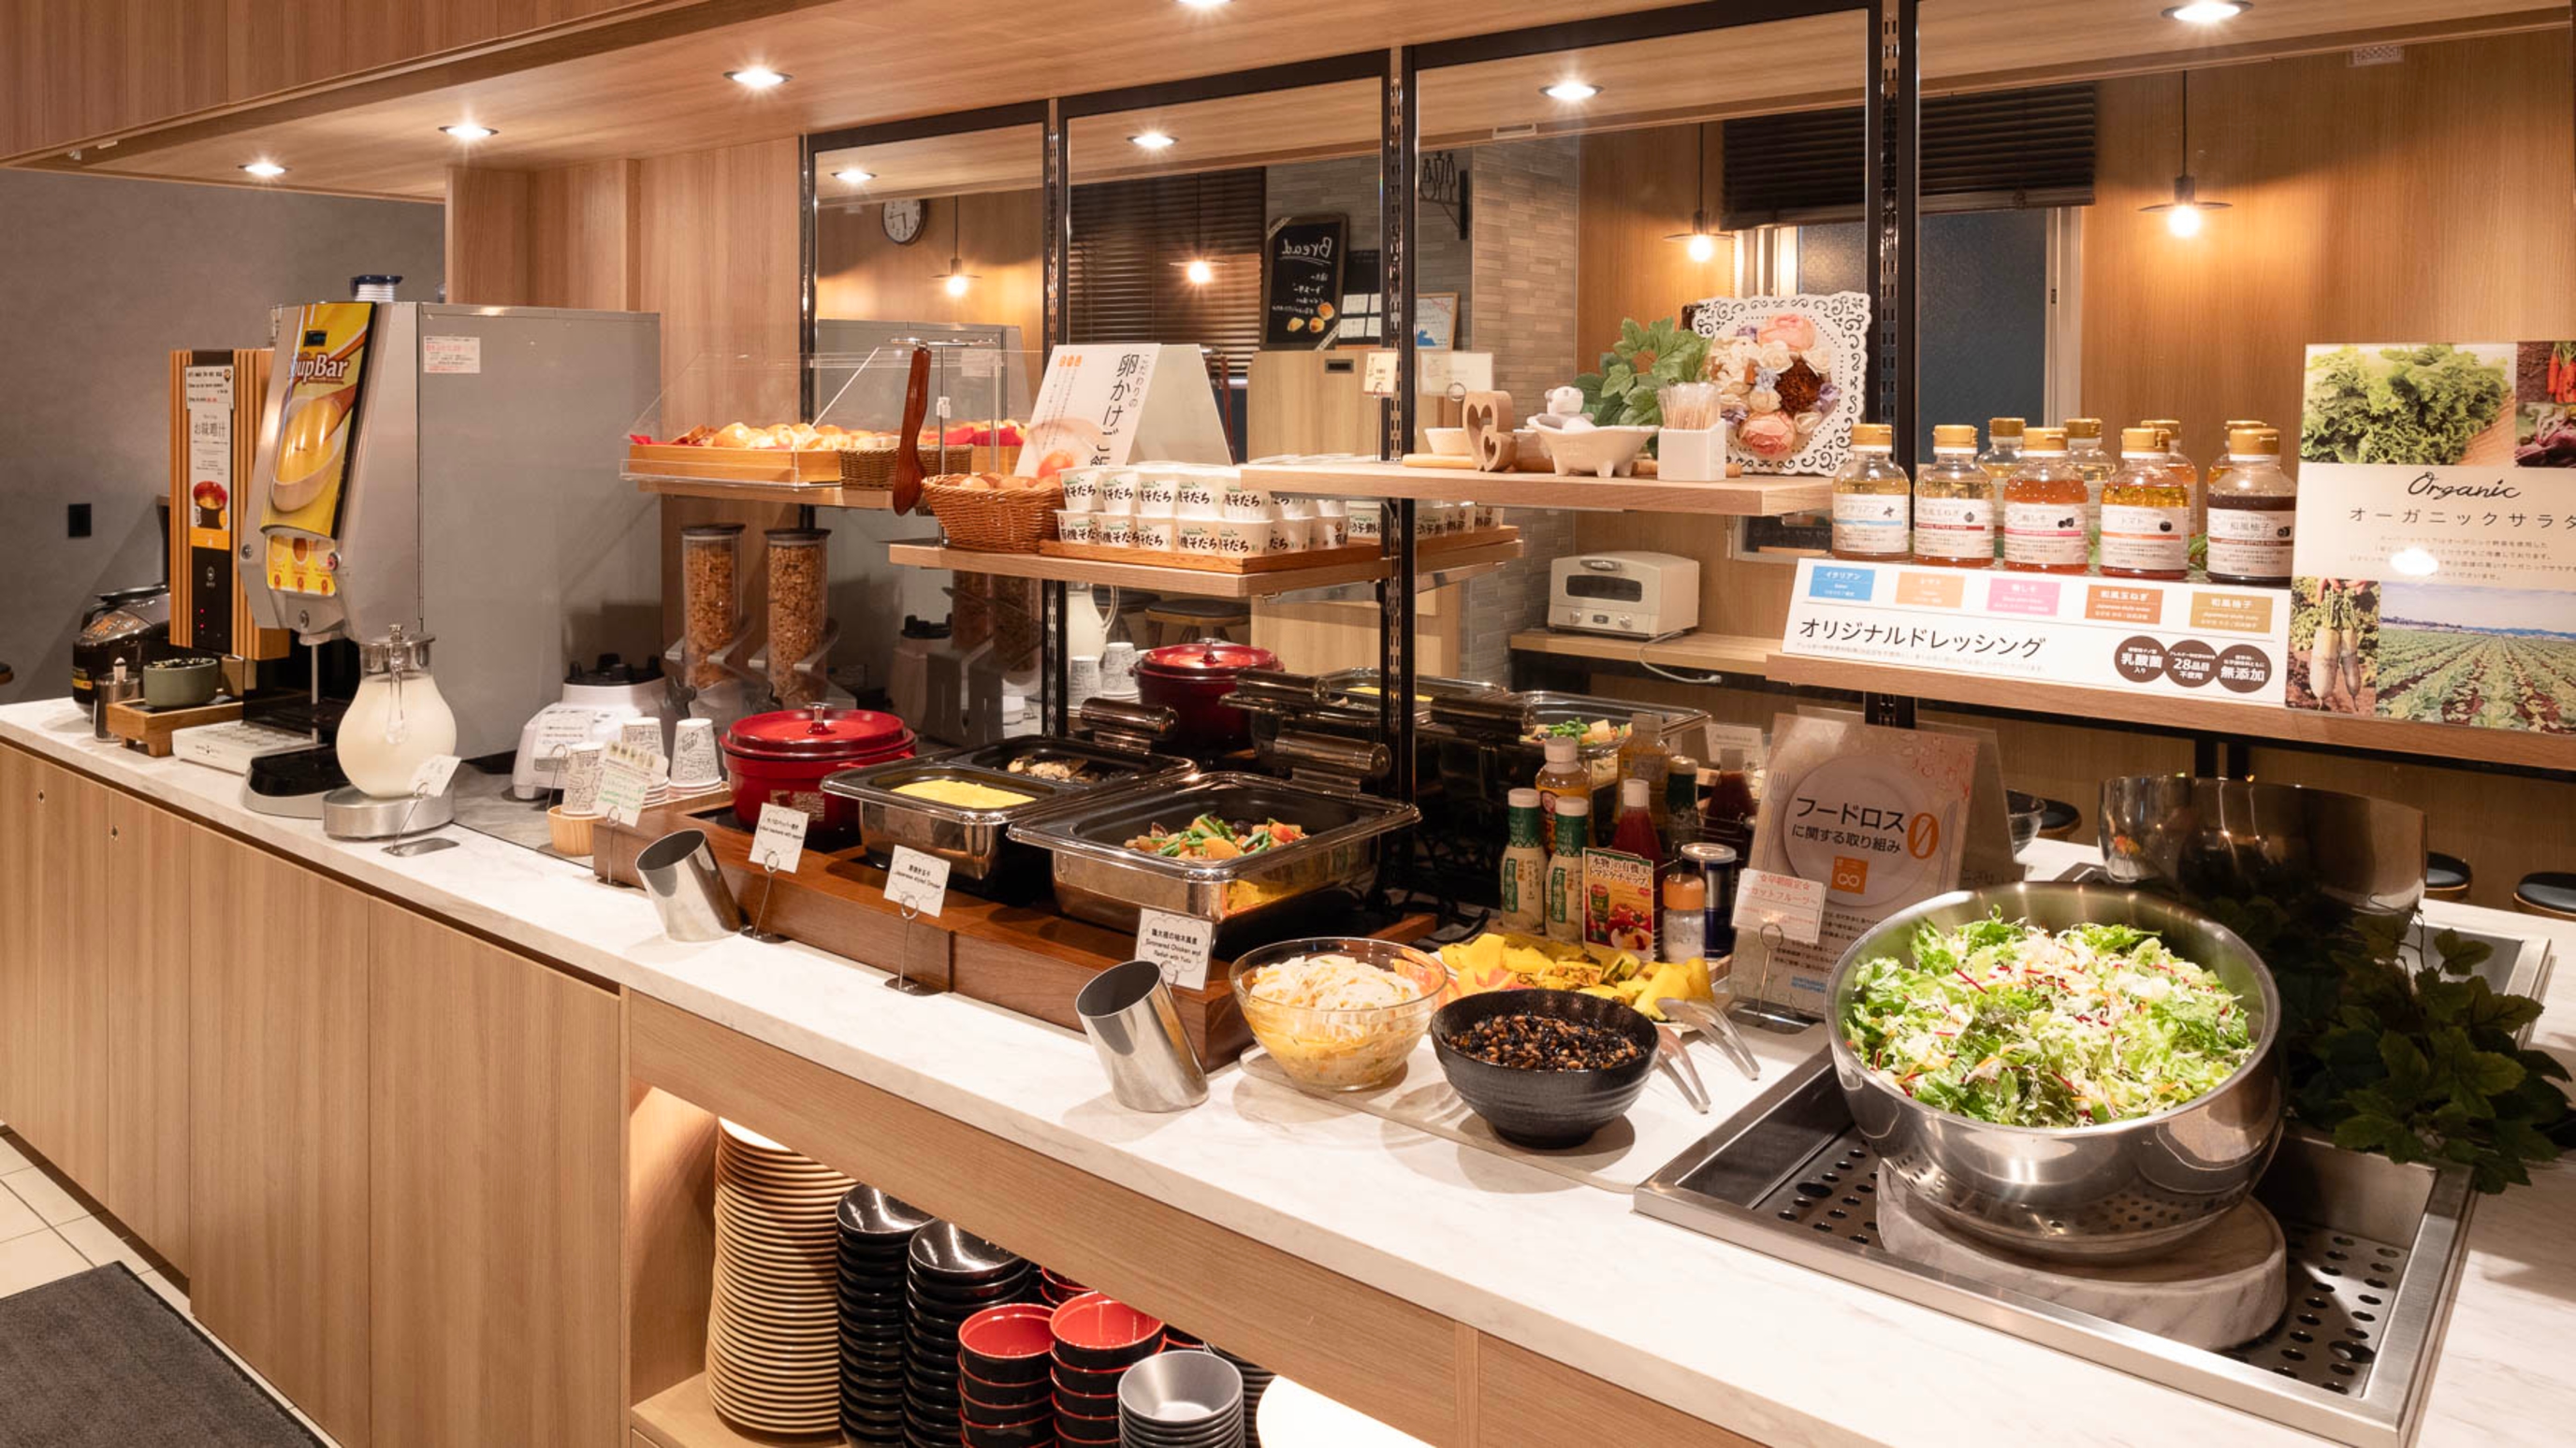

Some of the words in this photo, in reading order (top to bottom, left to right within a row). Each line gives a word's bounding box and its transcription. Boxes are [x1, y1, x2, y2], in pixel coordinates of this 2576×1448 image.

[2408, 471, 2521, 500] Organic
[1826, 571, 1862, 581] イタリアン
[2101, 590, 2150, 601] 和風玉ねぎ
[2211, 597, 2253, 609] 和風柚子
[1799, 617, 2046, 659] オリジナルドレッシング
[2120, 652, 2163, 669] 乳酸菌
[2173, 658, 2210, 672] 28品目
[2179, 671, 2204, 680] 不使用
[2220, 665, 2265, 682] 無添加
[1797, 797, 1905, 833] フードロス
[1907, 812, 1940, 860] 0
[1791, 824, 1901, 854] に関する取り組み
